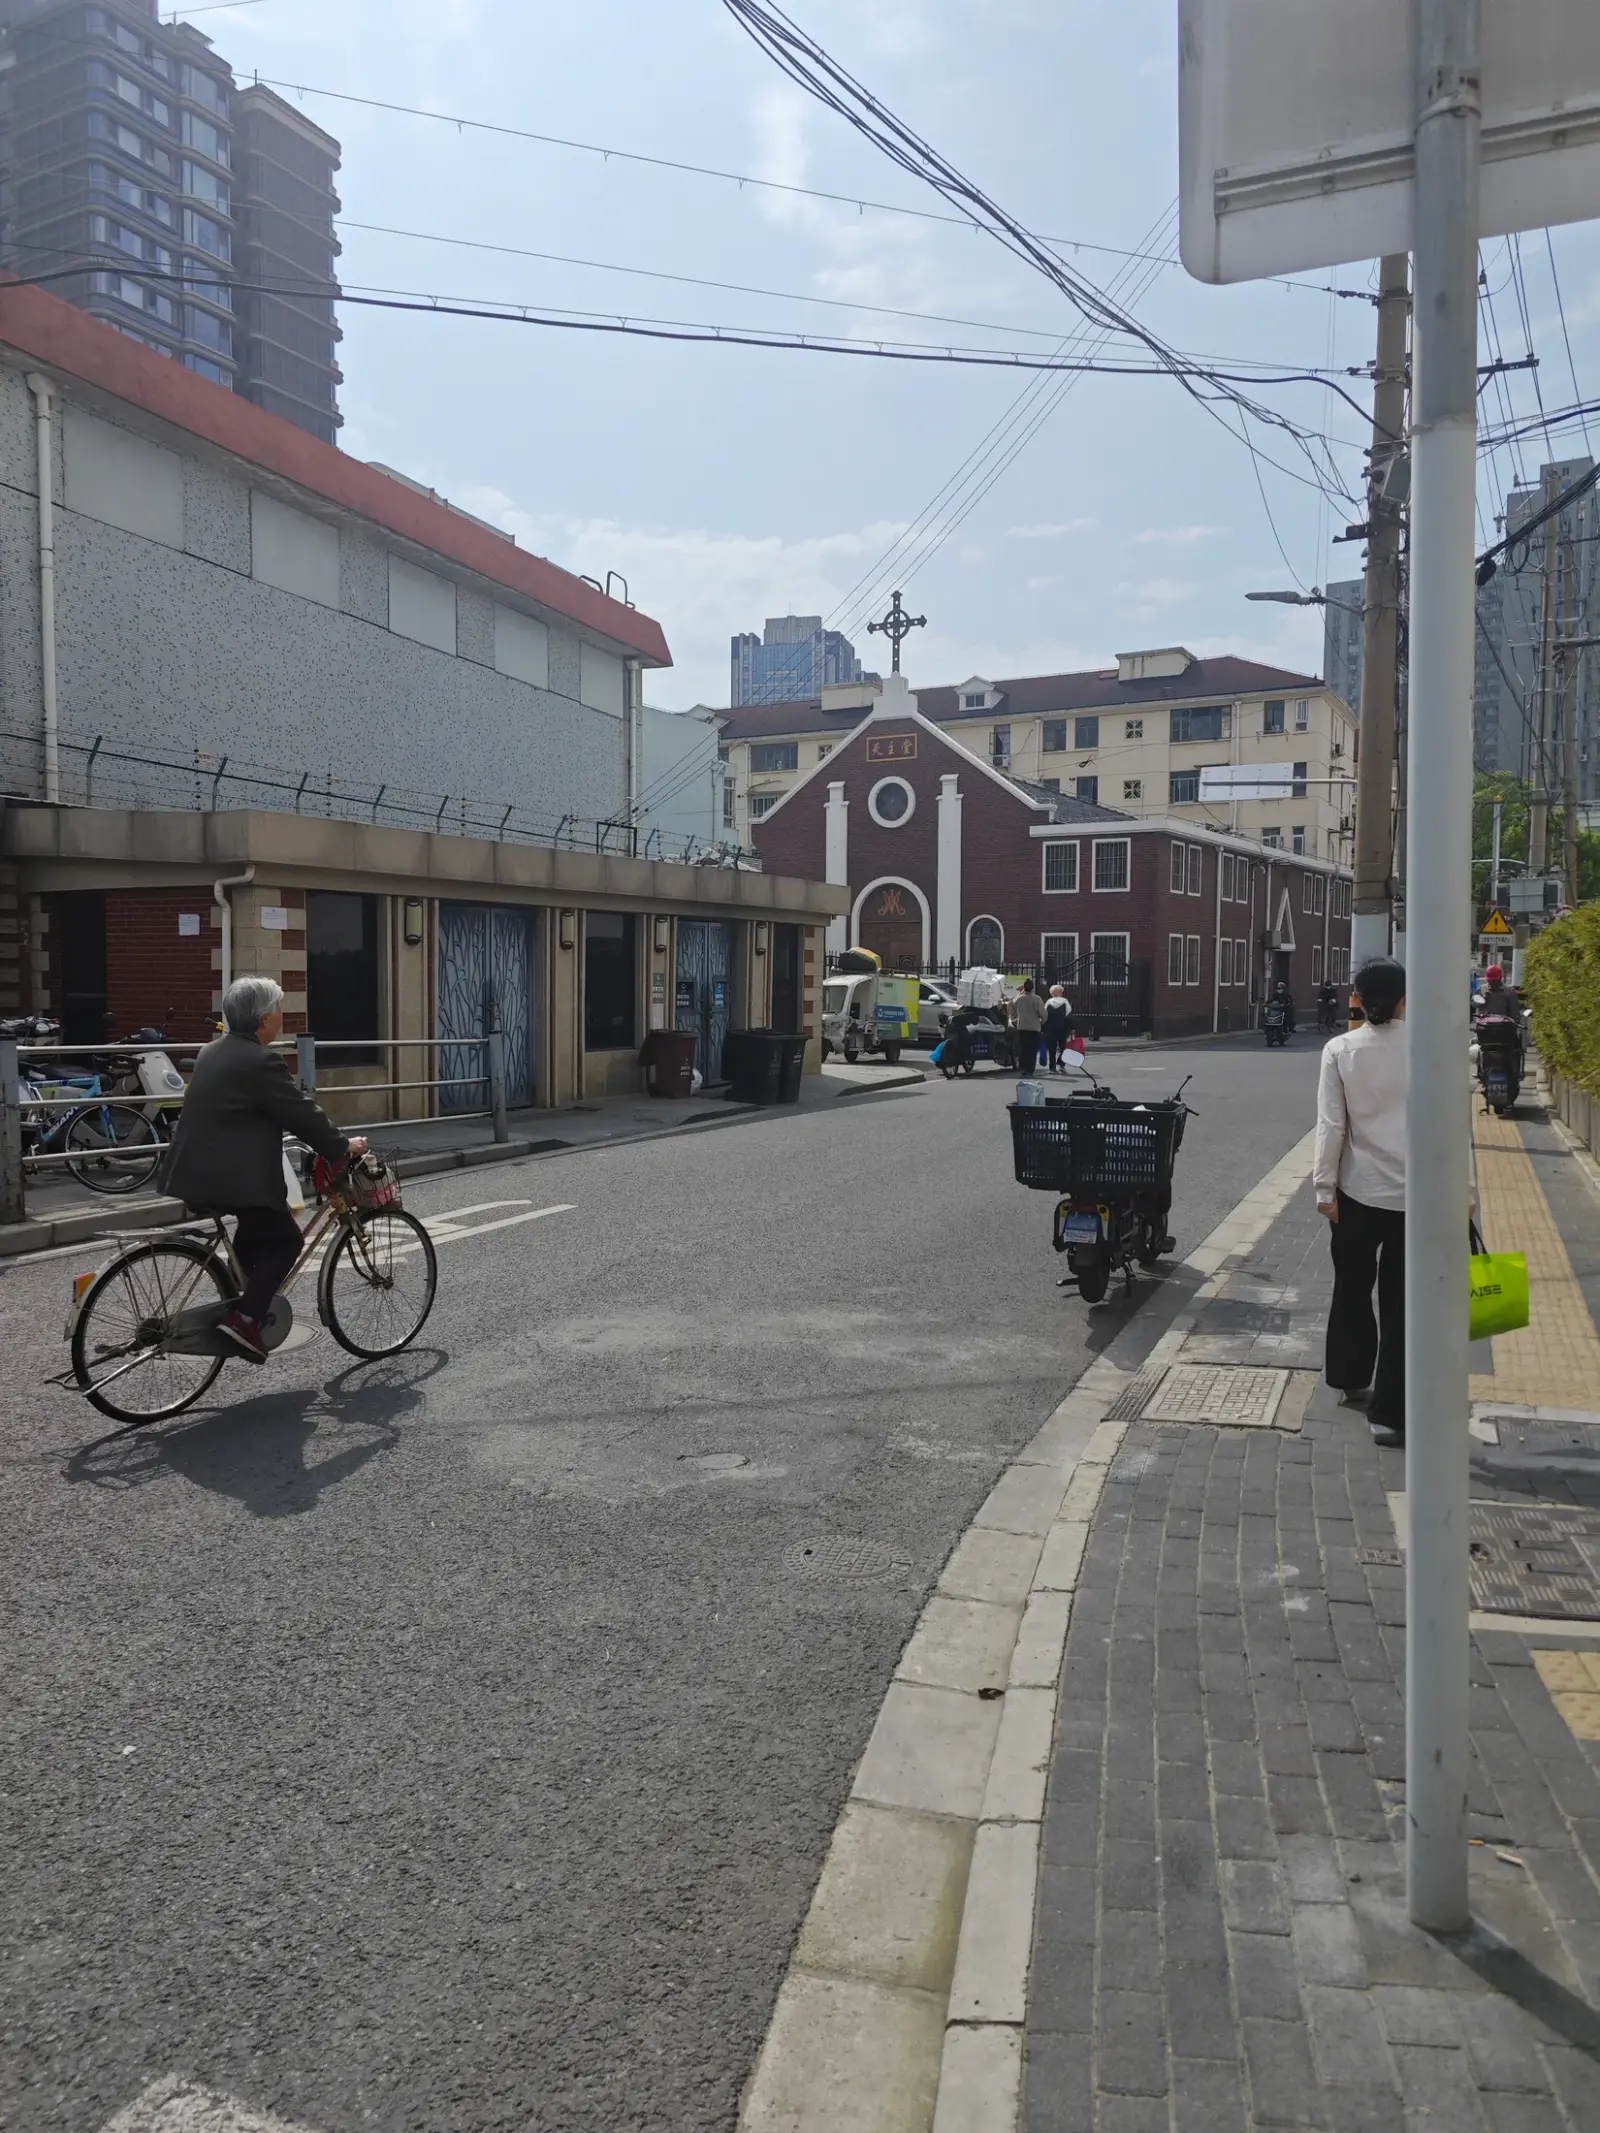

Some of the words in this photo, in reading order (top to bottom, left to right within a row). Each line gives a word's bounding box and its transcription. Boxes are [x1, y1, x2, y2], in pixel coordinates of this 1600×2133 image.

[871, 738, 913, 757] 天主堂
[48, 1105, 79, 1136] GIAN
[1469, 1283, 1503, 1298] AISE
